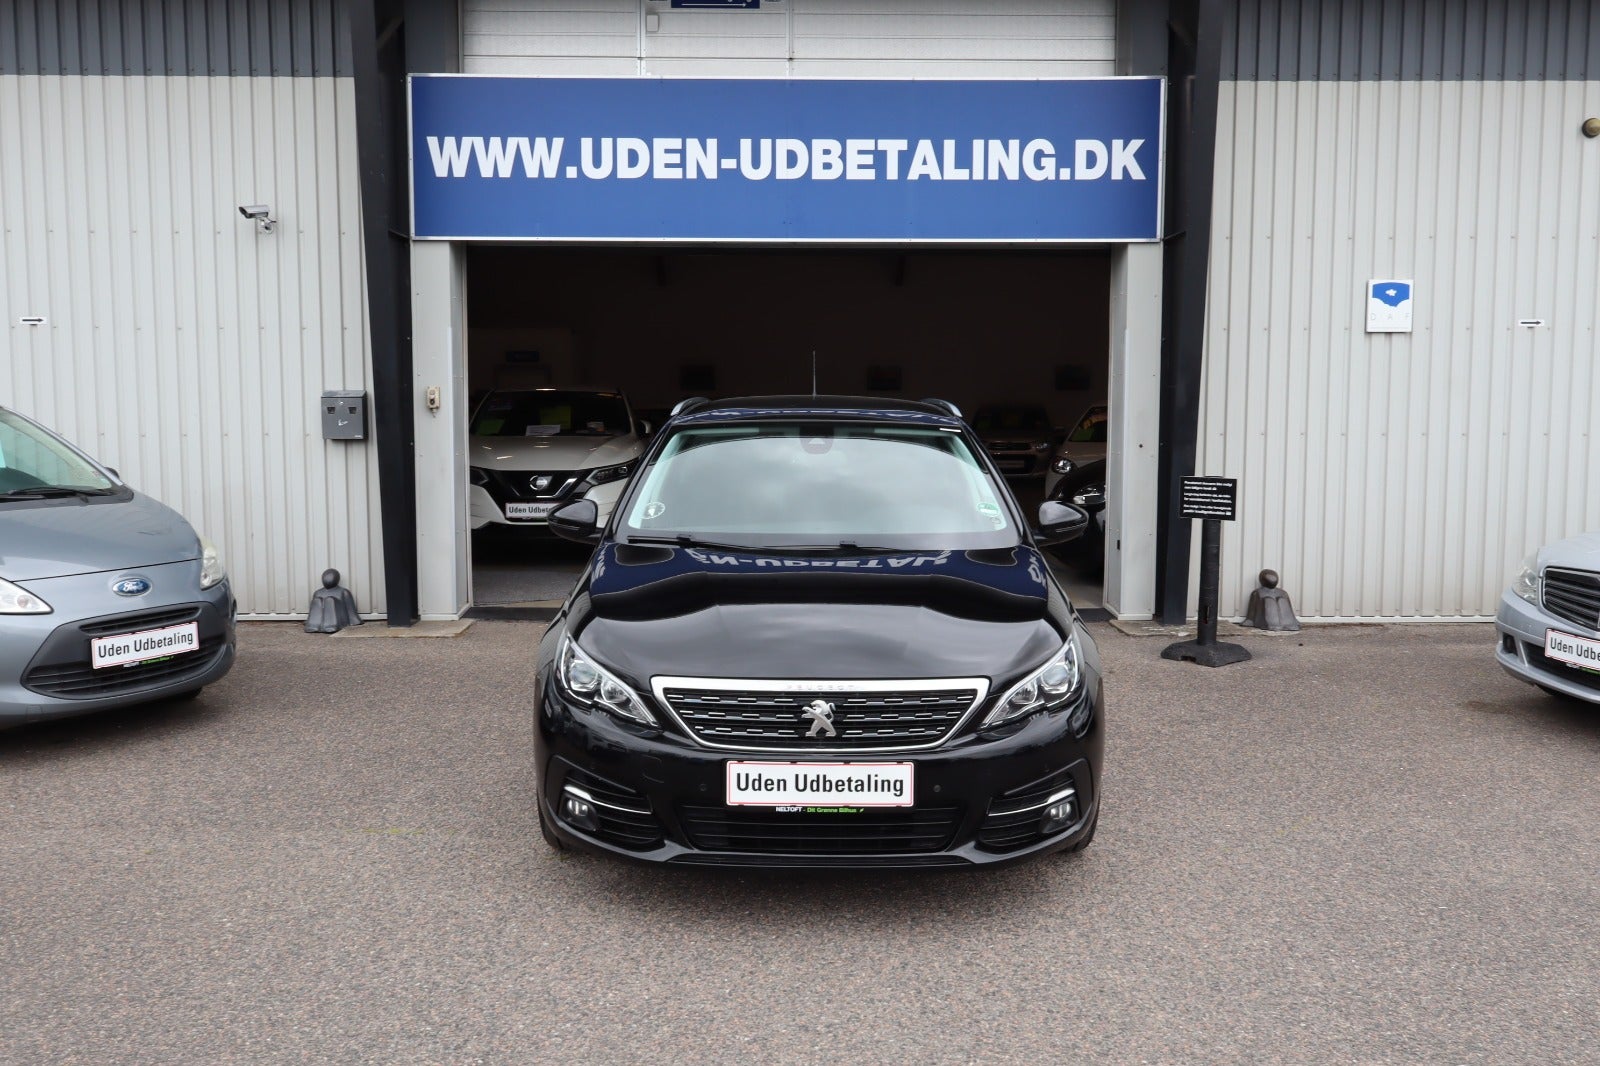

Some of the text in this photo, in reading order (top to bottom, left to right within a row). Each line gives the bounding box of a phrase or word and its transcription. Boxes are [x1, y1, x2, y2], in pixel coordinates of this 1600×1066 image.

[426, 135, 1147, 181] WWW.UDEN-UDBETALING.DK
[508, 506, 527, 514] Uden
[98, 632, 193, 658] Uden Udbetaling
[1550, 637, 1574, 655] Uden
[736, 773, 904, 797] Uden Udbetaling
